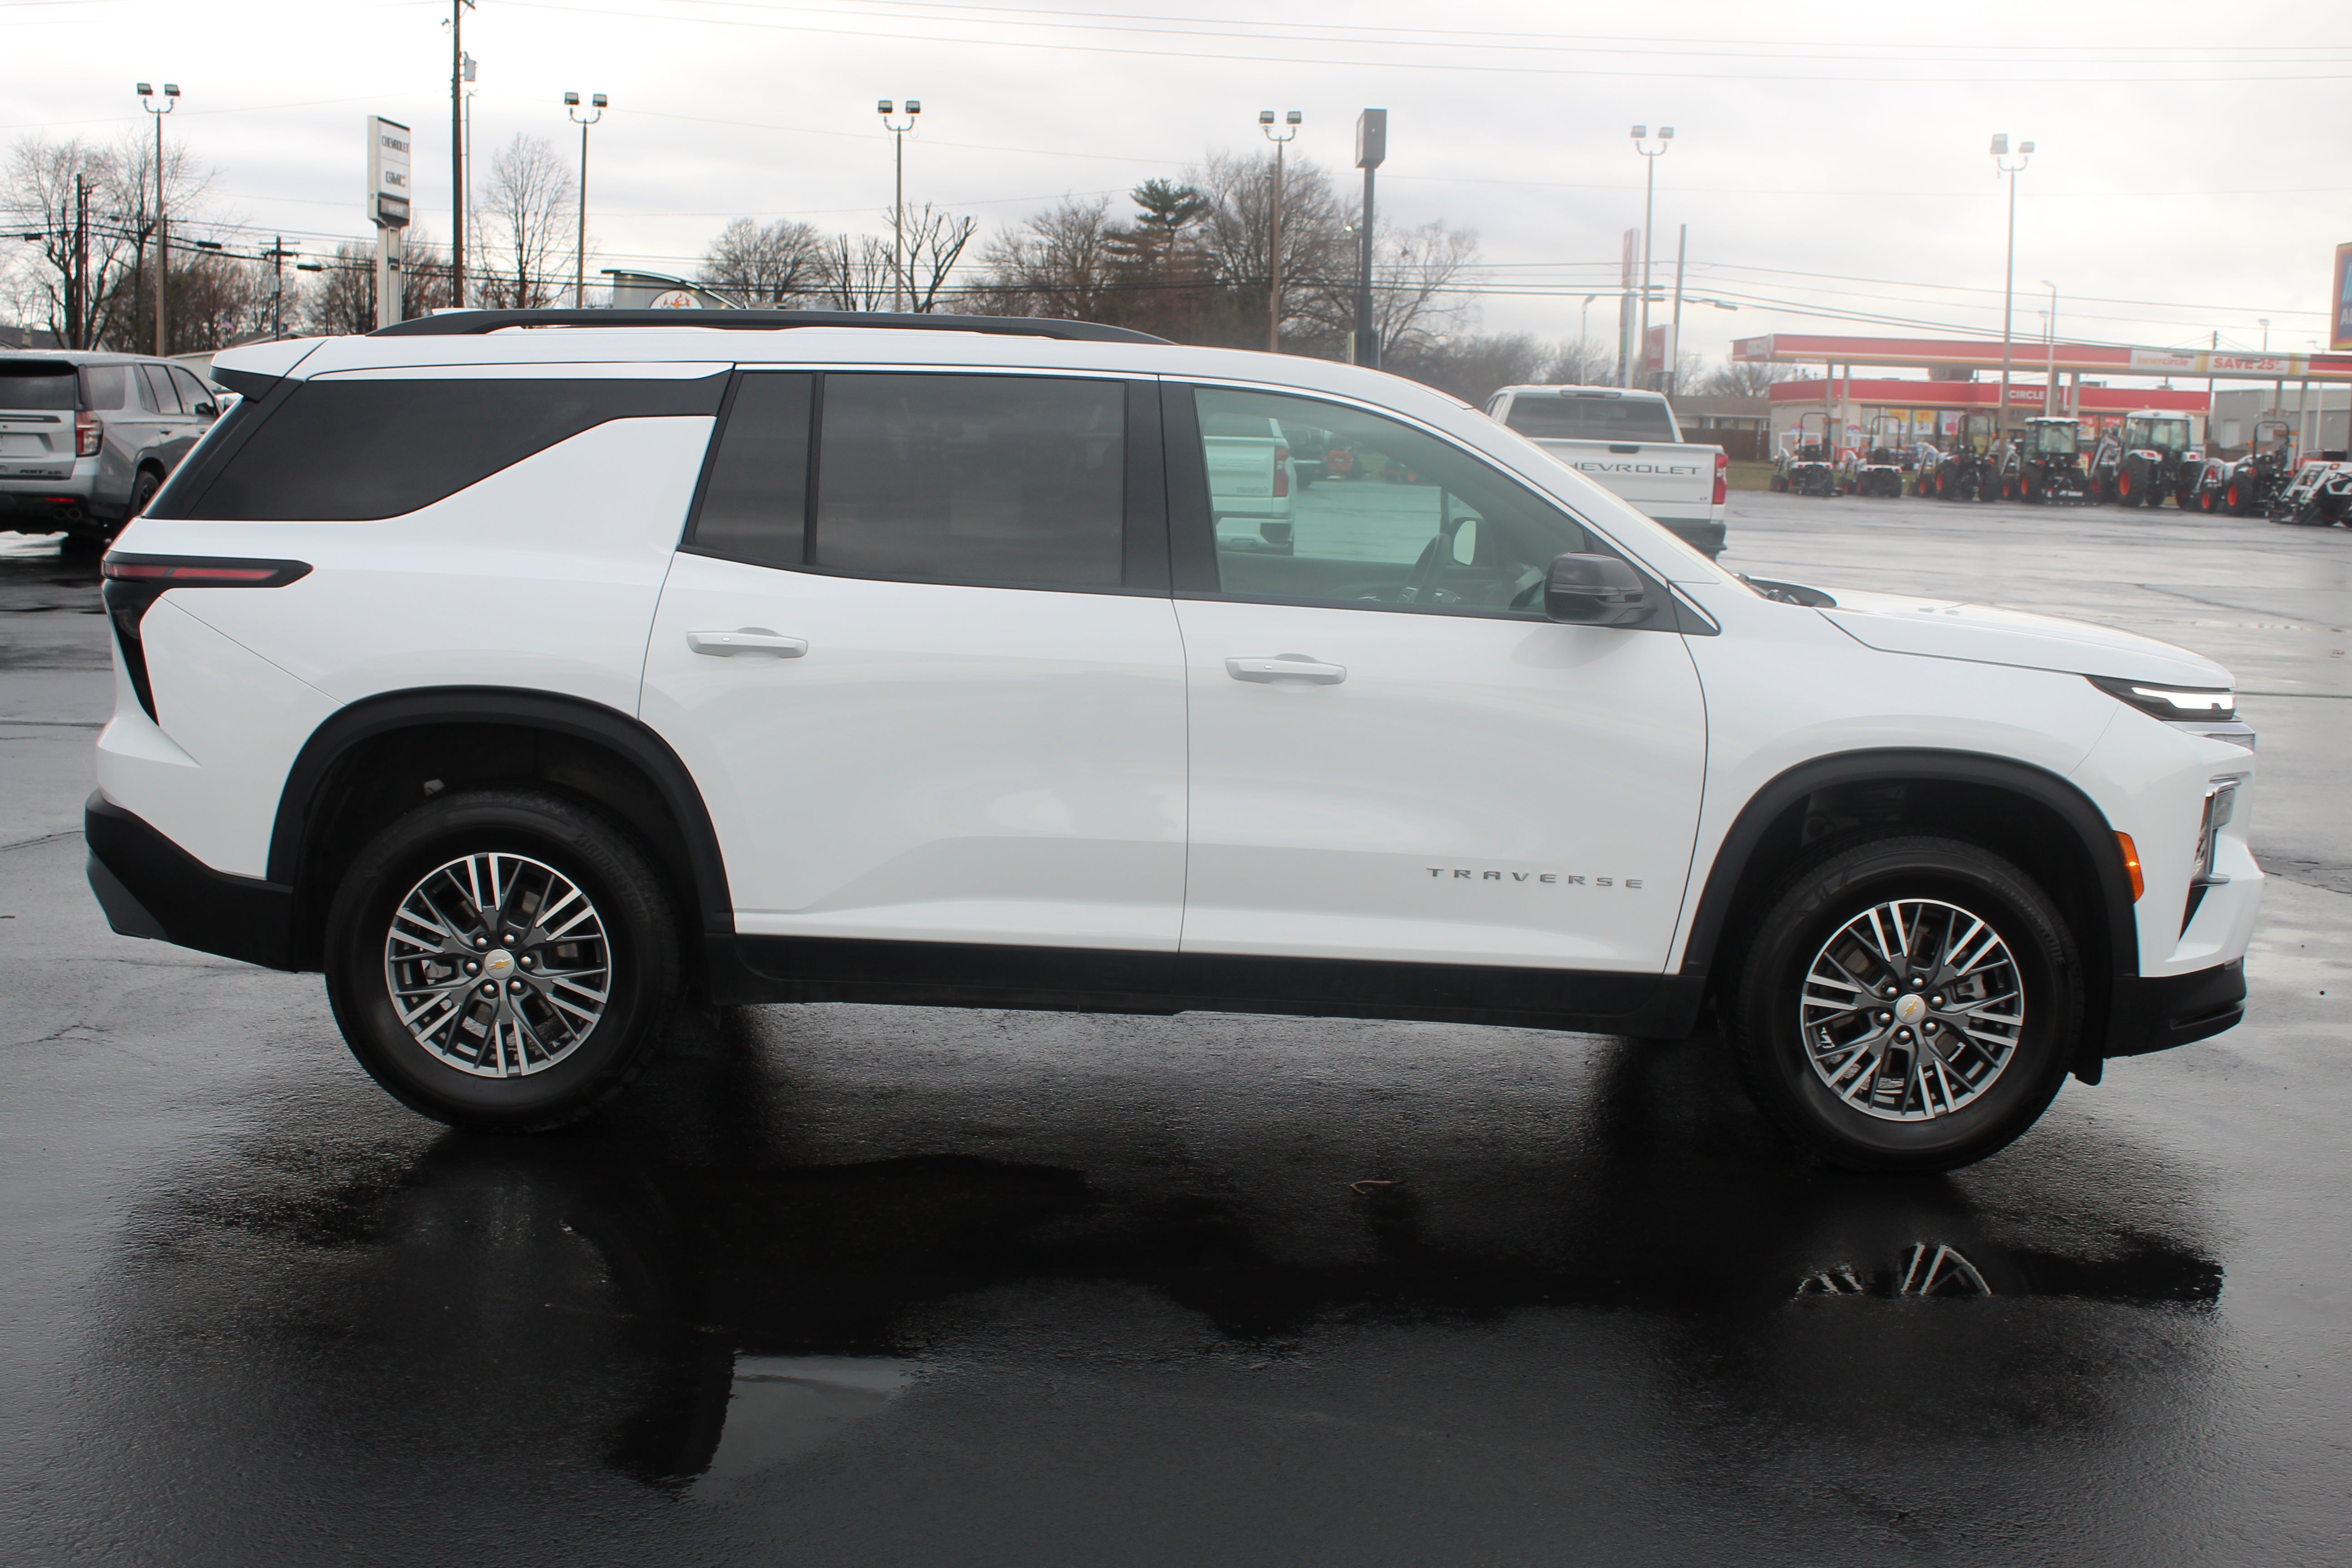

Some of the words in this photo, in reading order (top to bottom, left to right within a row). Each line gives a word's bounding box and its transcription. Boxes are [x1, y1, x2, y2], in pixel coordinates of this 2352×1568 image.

[386, 170, 406, 188] GMC
[2214, 357, 2254, 369] SAVE
[2009, 390, 2045, 400] CIRCLE
[1571, 462, 1701, 475] HEVROLET
[572, 833, 651, 927] BRIDGESTON
[1426, 867, 1643, 888] TRAVERSE
